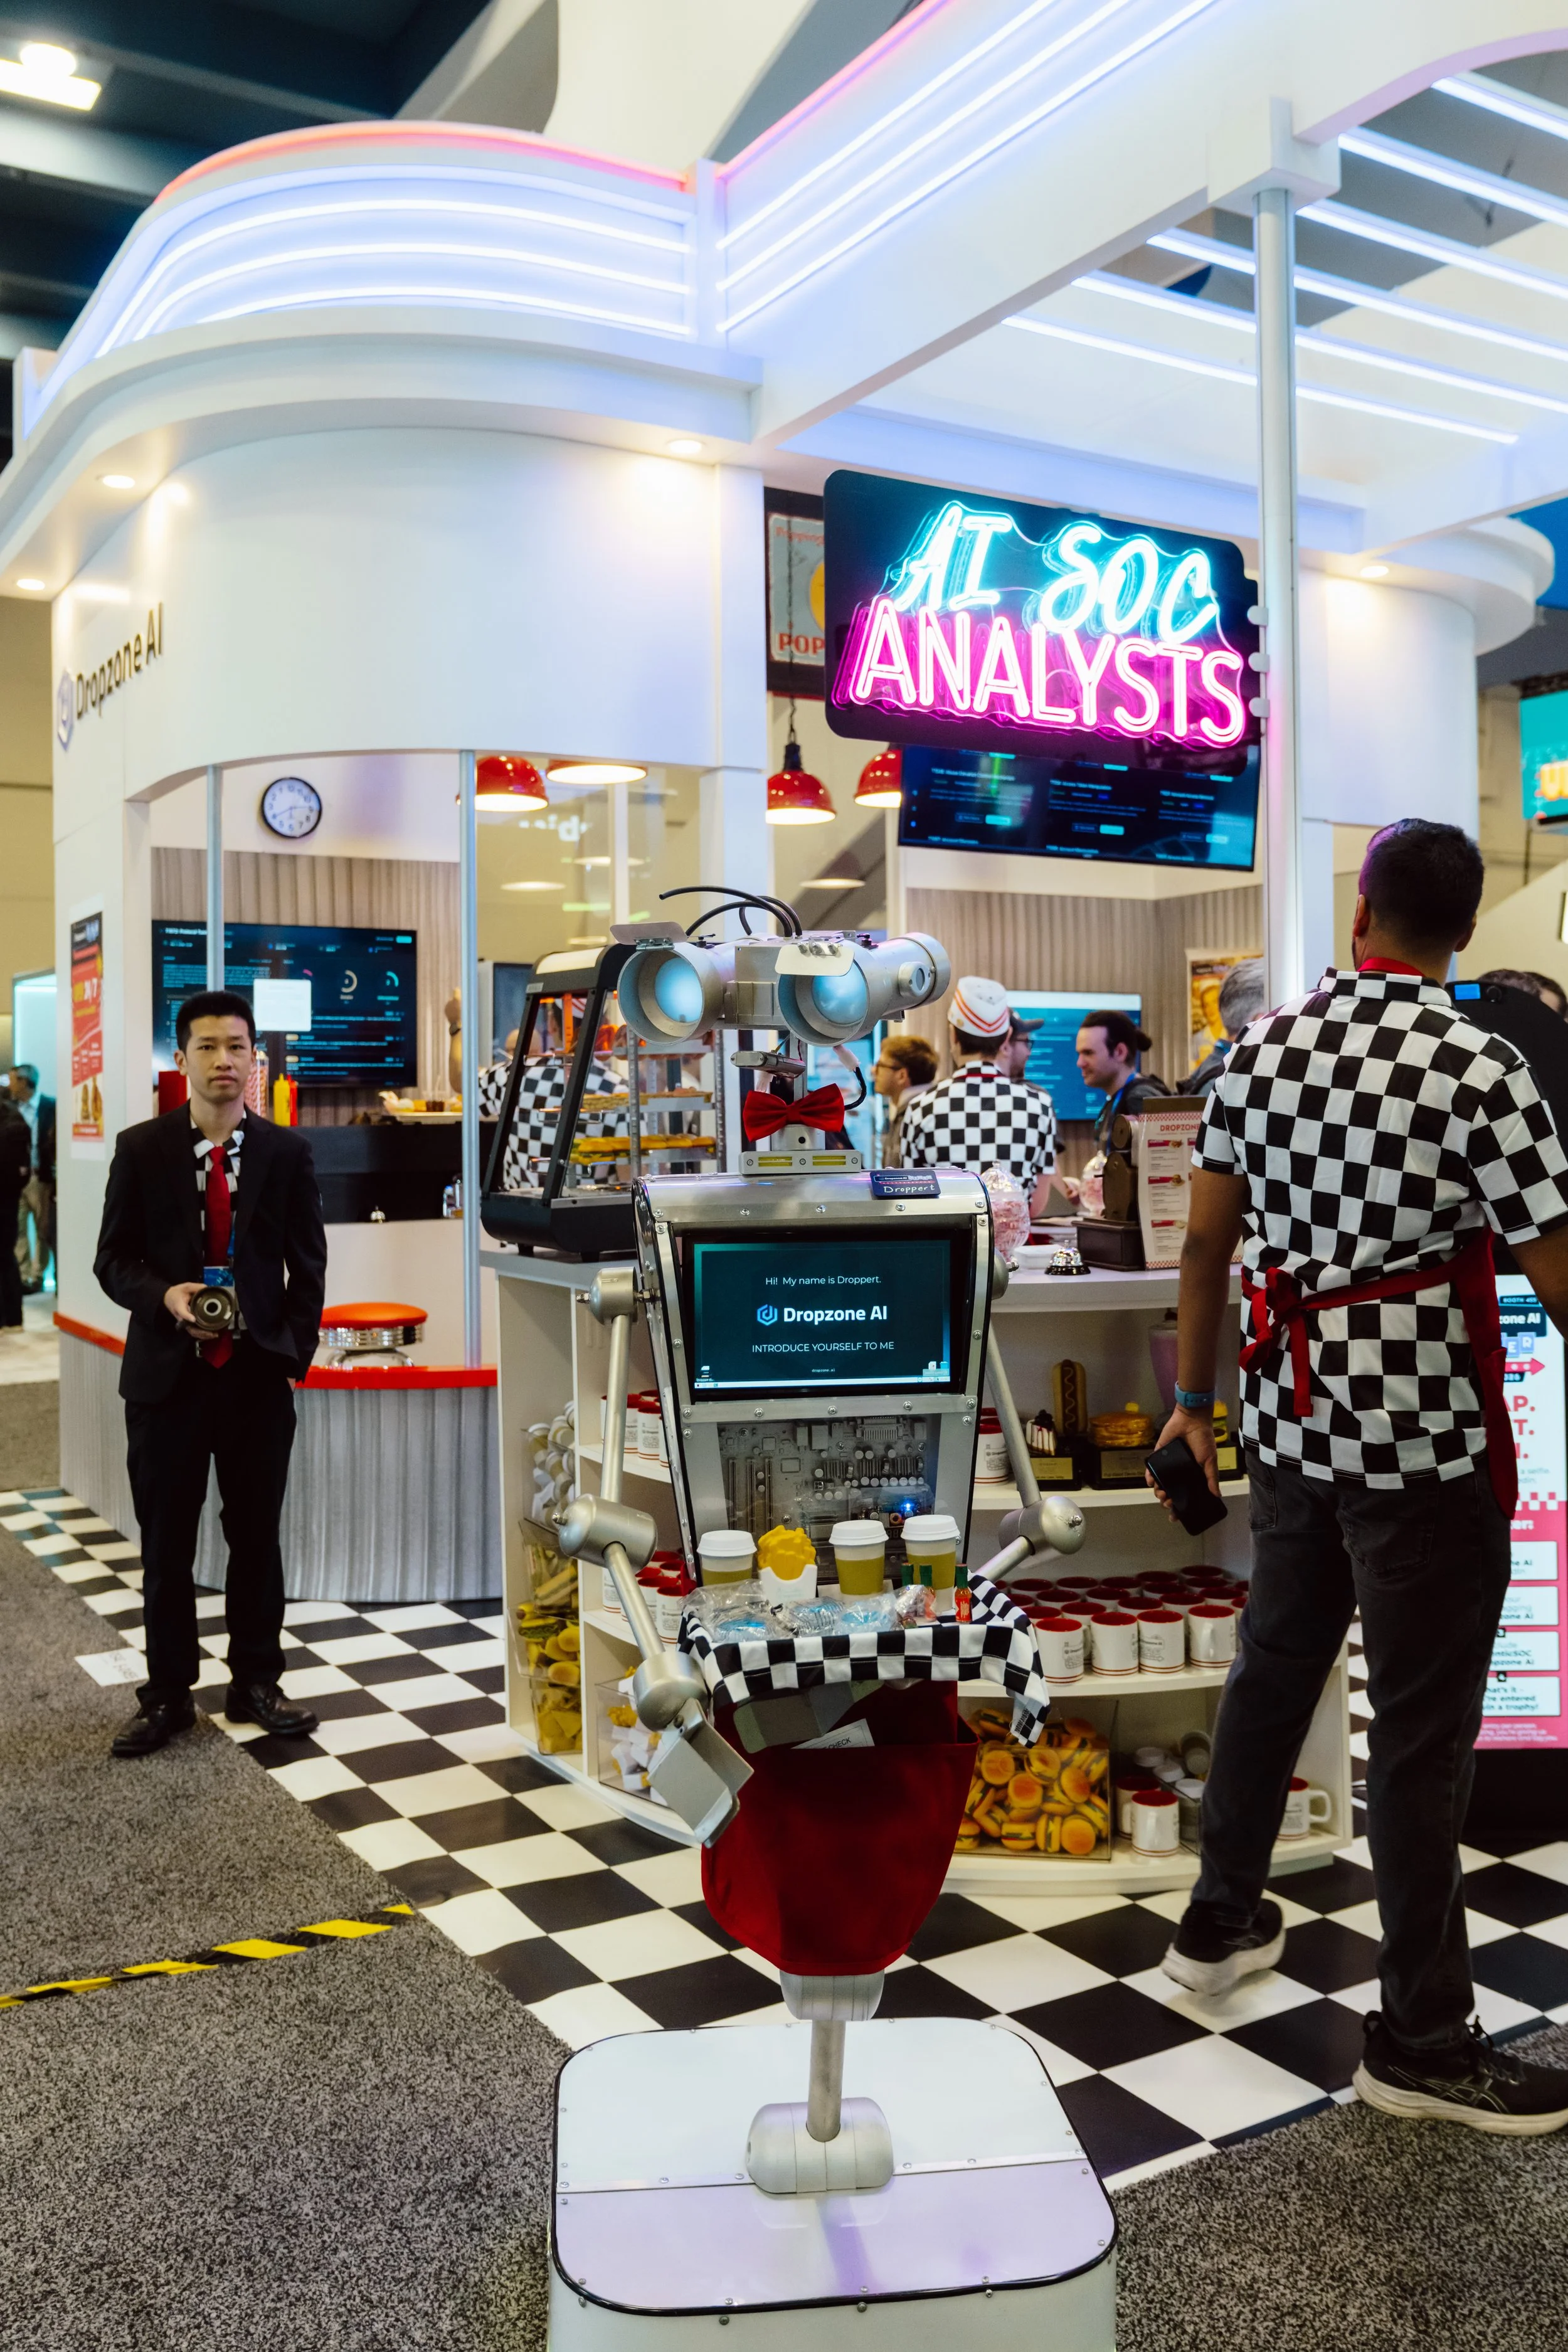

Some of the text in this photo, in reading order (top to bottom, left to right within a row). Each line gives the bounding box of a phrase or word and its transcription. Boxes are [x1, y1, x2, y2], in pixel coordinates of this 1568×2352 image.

[894, 502, 1219, 645] AI SOC
[77, 601, 162, 720] Dropzone AI
[849, 597, 1244, 745] ANALYSTS
[884, 1185, 935, 1193] Droppert
[766, 1277, 778, 1285] Hi!
[783, 1277, 797, 1286] My
[837, 1276, 881, 1285] Droppert.
[784, 1306, 887, 1325] Dropzone AI
[1527, 1313, 1540, 1324] AI
[752, 1343, 810, 1353] INTRODUCE
[812, 1342, 862, 1351] YOURSELF
[864, 1342, 877, 1350] TO
[829, 1737, 851, 1748] CHECK
